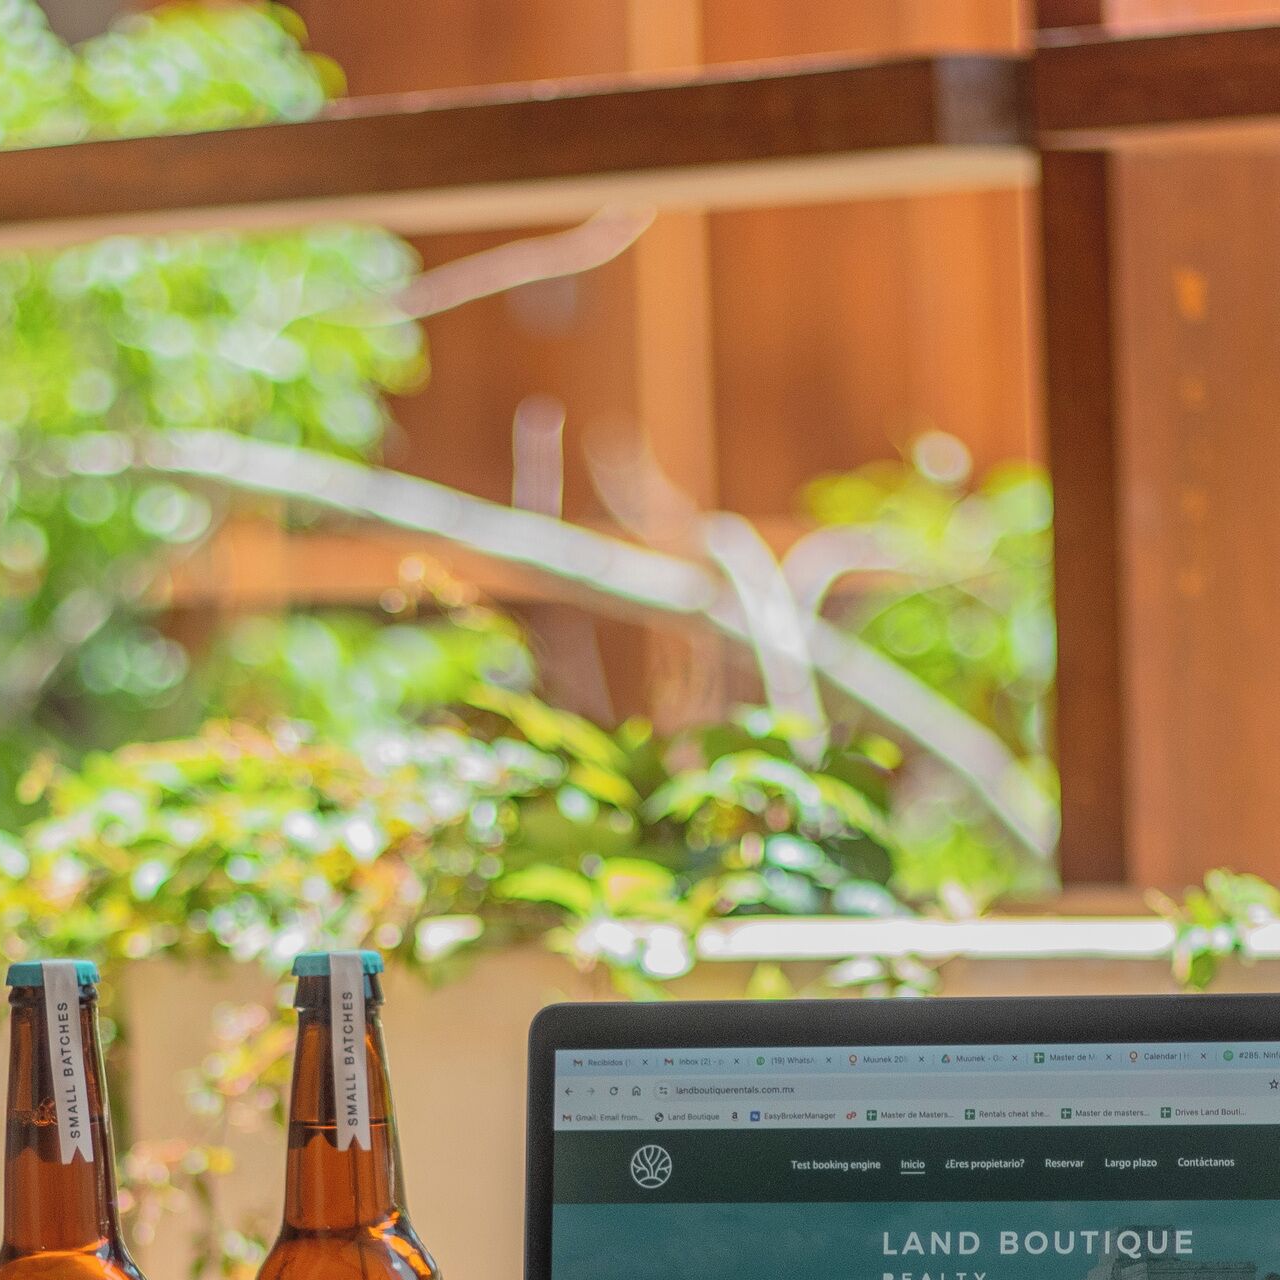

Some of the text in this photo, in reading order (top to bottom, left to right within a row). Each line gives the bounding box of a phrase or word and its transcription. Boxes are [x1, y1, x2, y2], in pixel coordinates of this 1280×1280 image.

[342, 991, 359, 1127] SMALL BATCHES
[863, 1056, 892, 1064] Muunek
[1049, 1053, 1074, 1061] Master
[1076, 1053, 1087, 1061] de
[1144, 1052, 1177, 1060] Calendar
[587, 1059, 623, 1067] Recibidos
[771, 1057, 785, 1066] (19)
[57, 1002, 81, 1138] SMALL BATCHES
[676, 1086, 795, 1096] landboutiquerentals.com.mx
[668, 1112, 720, 1122] Land Boutique
[764, 1112, 836, 1121] EasyBrokerManager
[880, 1111, 906, 1119] Master
[907, 1111, 918, 1119] de
[979, 1110, 1005, 1118] Rentals
[1007, 1110, 1029, 1118] cheat
[1075, 1109, 1100, 1117] Master
[1102, 1109, 1112, 1117] de
[1175, 1108, 1199, 1117] Drives
[1200, 1108, 1219, 1116] Land
[791, 1159, 881, 1172] Test booking engine
[900, 1159, 926, 1169] Inicio
[945, 1158, 1025, 1171] ¿Eres propietario?
[1044, 1158, 1084, 1168] Reservar
[1105, 1157, 1158, 1170] Largo plazo
[1177, 1156, 1235, 1167] Contáctanos
[882, 1229, 1194, 1259] LAND BOUTIQUE
